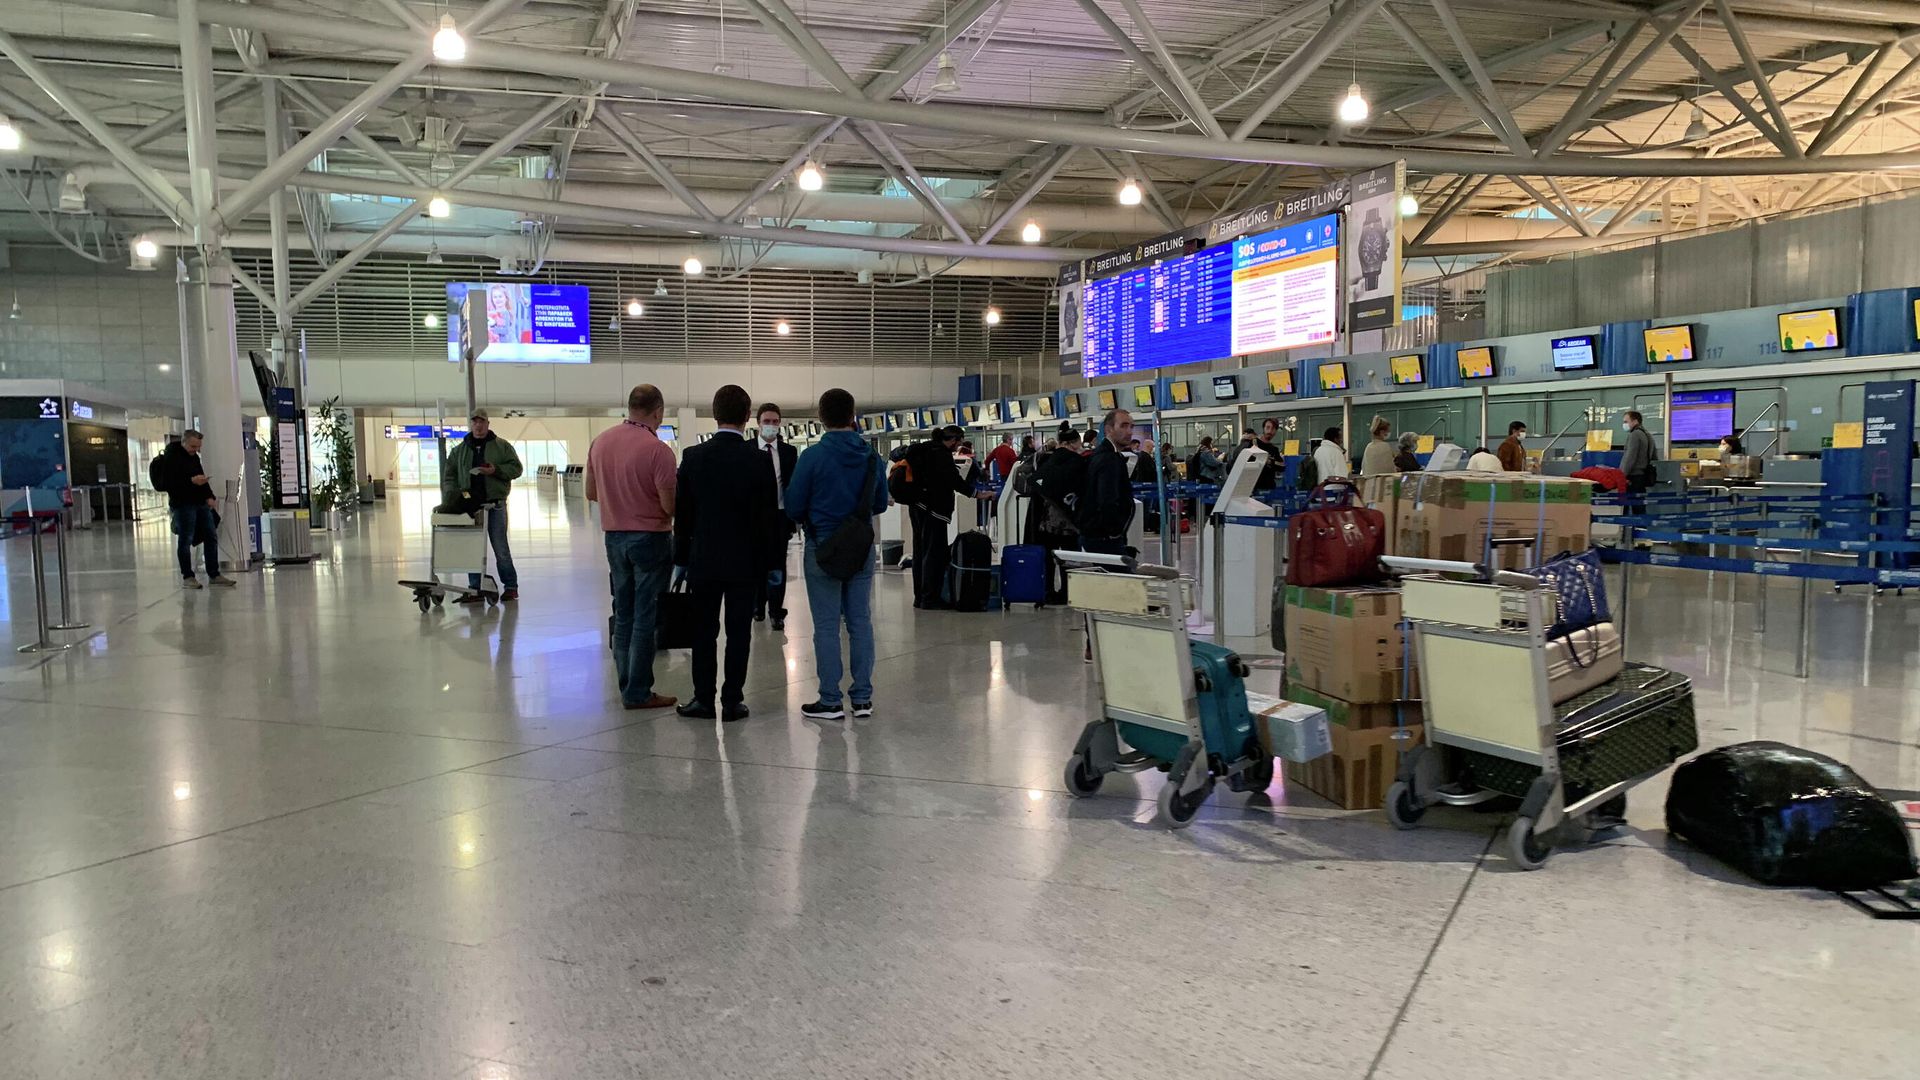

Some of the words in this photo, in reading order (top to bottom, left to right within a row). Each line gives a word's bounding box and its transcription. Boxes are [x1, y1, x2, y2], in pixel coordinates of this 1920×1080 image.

[1358, 176, 1387, 191] BREITLING
[1286, 187, 1343, 216] BREITLING
[1219, 210, 1268, 236] BREITLING
[1144, 236, 1184, 258] BREITLING
[1238, 242, 1255, 258] SOS
[1096, 251, 1131, 272] BREITLING
[1706, 346, 1724, 360] 117
[1504, 366, 1516, 376] 119
